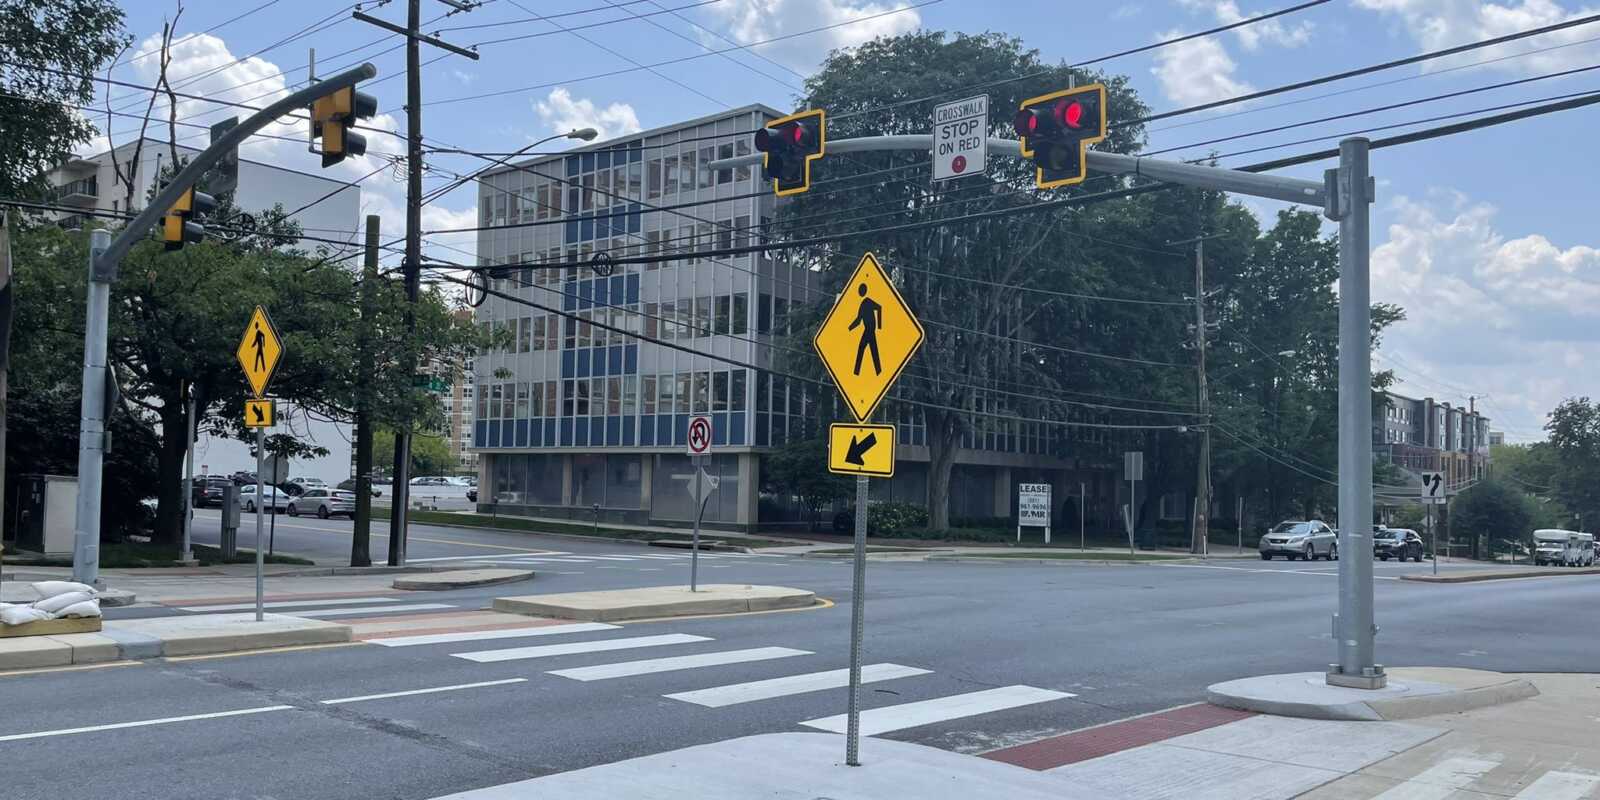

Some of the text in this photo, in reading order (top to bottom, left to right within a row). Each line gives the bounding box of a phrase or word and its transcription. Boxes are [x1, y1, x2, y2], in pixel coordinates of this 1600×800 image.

[938, 100, 984, 121] CROSSWALK
[942, 120, 979, 139] STOP
[939, 136, 980, 155] ON RED
[1020, 485, 1047, 493] LEASE
